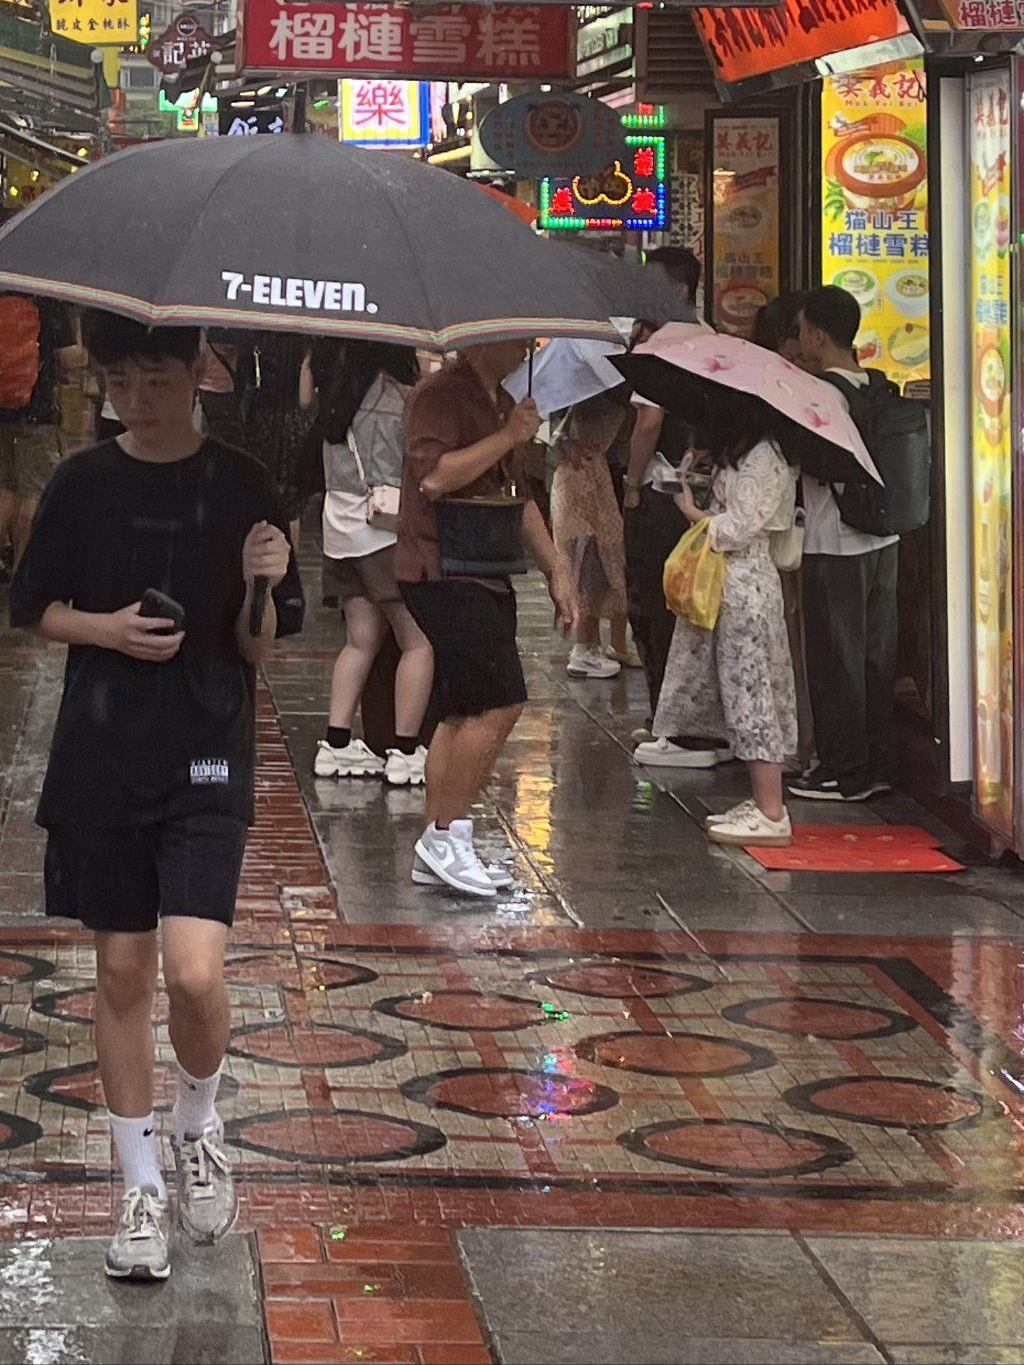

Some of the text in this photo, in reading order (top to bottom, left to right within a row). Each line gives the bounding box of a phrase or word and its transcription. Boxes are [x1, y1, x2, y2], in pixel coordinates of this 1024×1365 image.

[959, 0, 1024, 28] 榴槤
[269, 10, 542, 66] 榴槤雪糕
[355, 84, 406, 126] 樂
